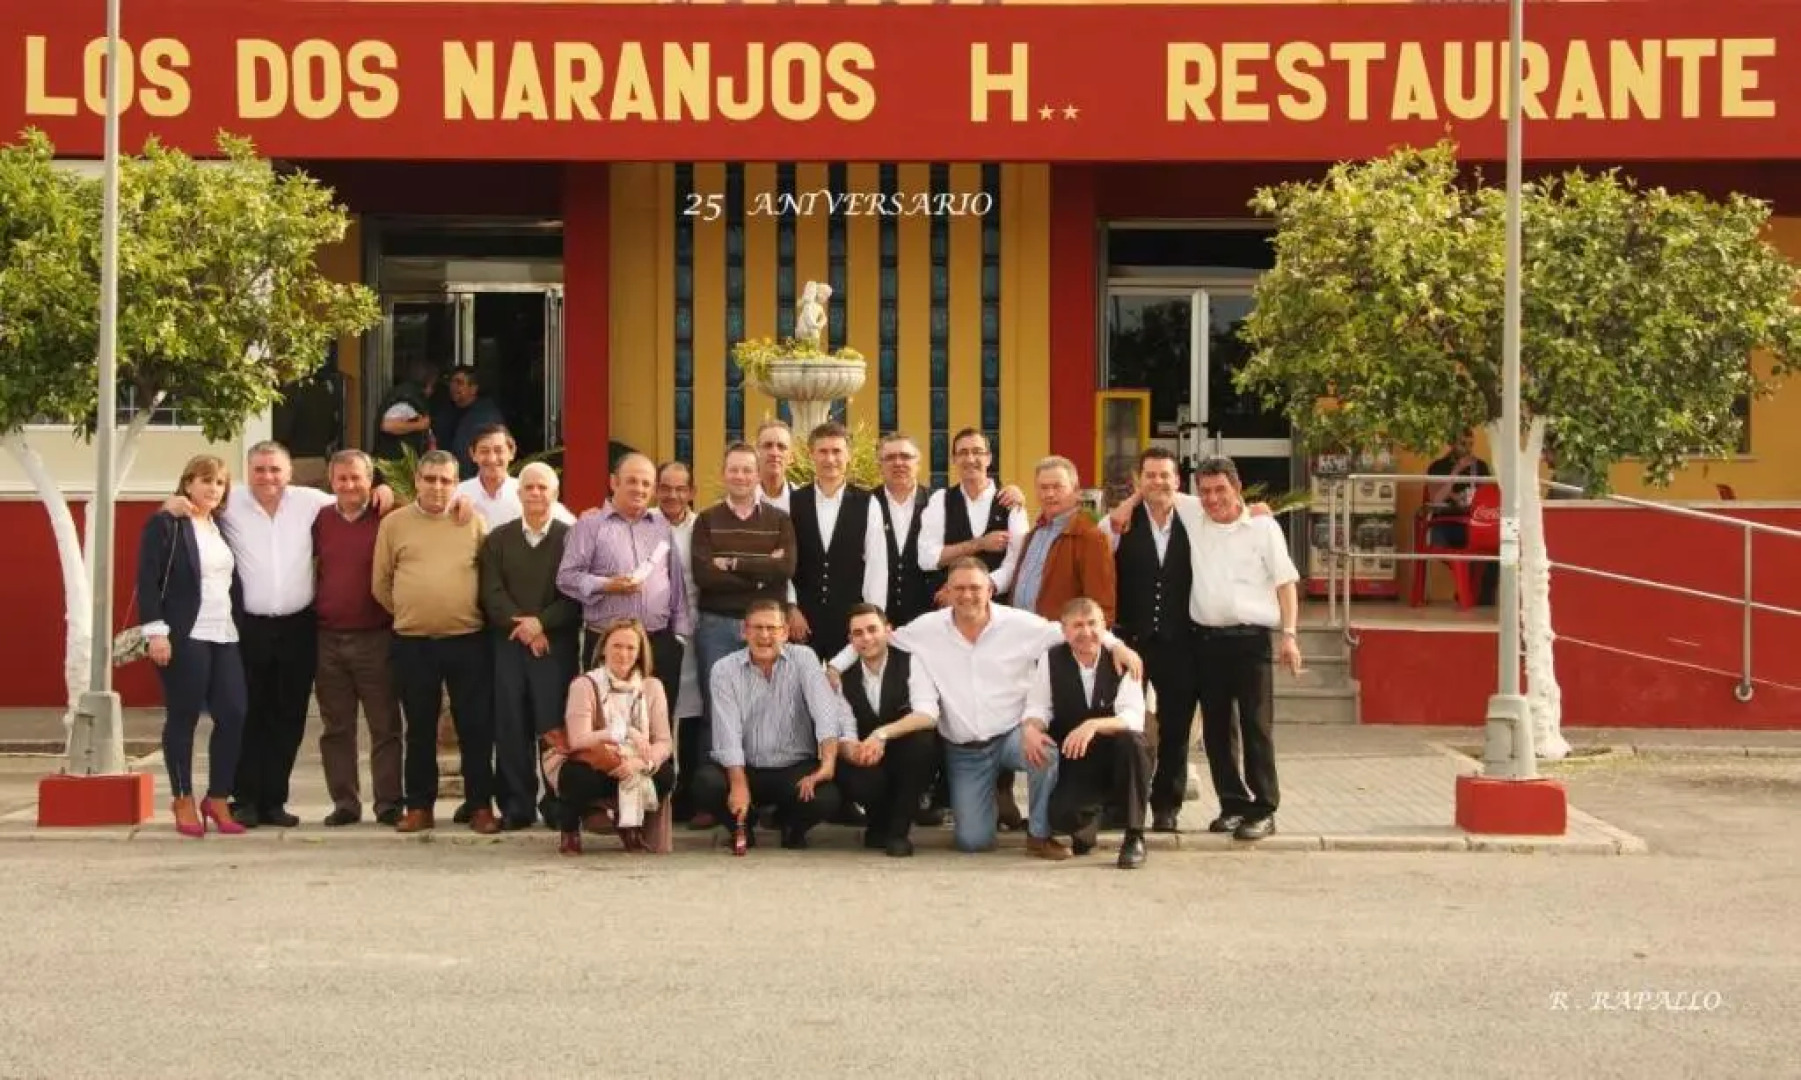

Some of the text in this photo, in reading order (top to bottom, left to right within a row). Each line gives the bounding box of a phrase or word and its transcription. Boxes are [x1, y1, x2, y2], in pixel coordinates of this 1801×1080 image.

[25, 36, 1776, 122] LOS DOS NARANJOS H RESTAURANTE
